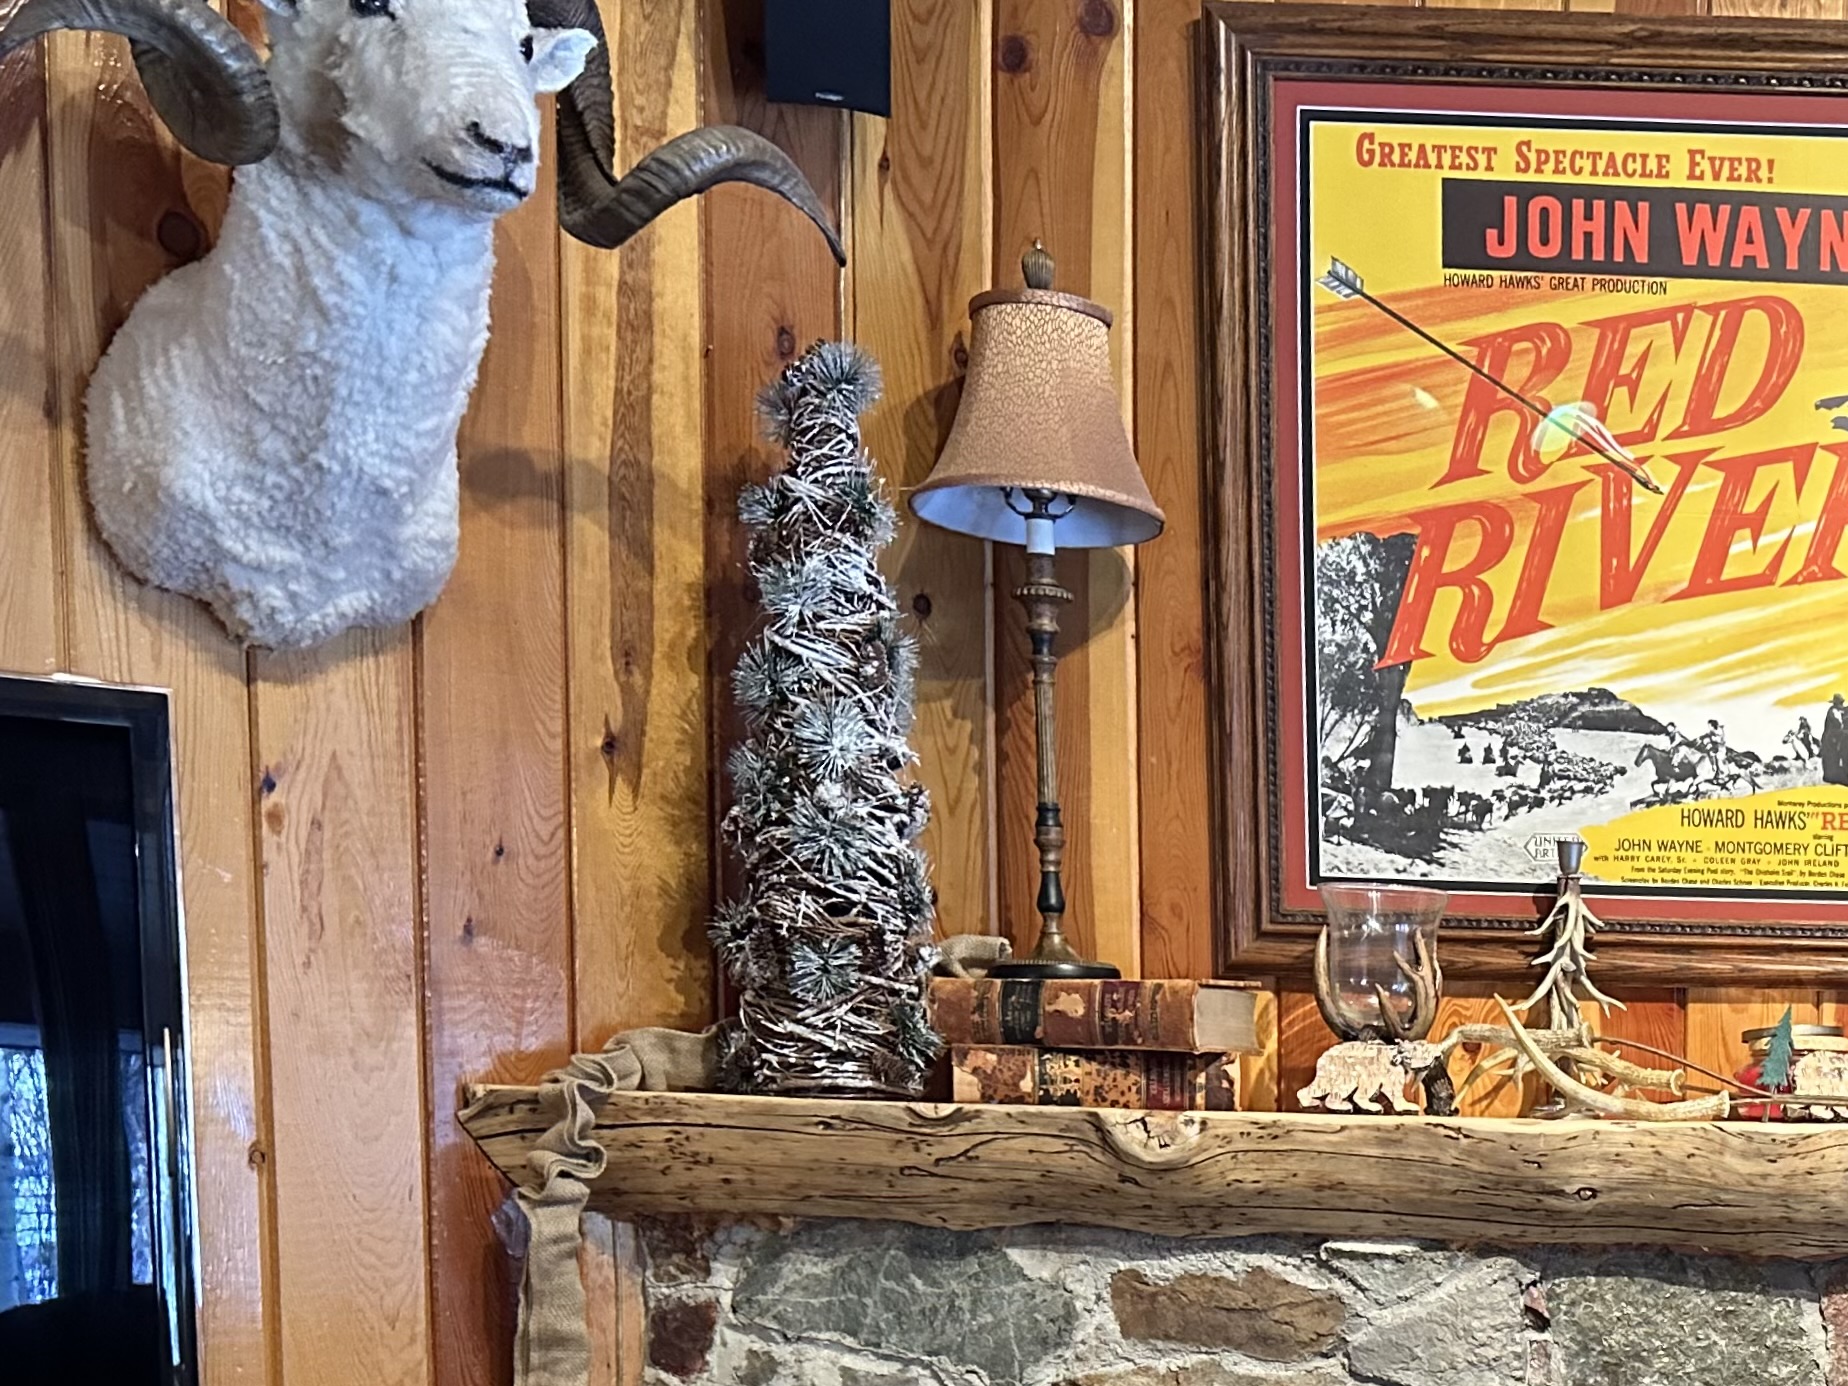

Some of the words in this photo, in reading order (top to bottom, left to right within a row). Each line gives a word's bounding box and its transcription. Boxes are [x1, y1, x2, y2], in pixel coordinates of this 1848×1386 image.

[1356, 132, 1498, 172] GREATEST
[1515, 139, 1671, 179] SPECTACLE
[1687, 148, 1775, 184] EVER!
[1486, 195, 1650, 264] JOHN
[1443, 273, 1494, 289] HOWARD
[1500, 274, 1544, 290] HAWKS'
[1550, 276, 1587, 292] GREAT
[1591, 277, 1667, 296] PRODUCTION
[1429, 295, 1805, 491] RED
[1680, 808, 1745, 828] HOWARD
[1754, 809, 1809, 830] HAWKS'
[1614, 838, 1651, 852] JOHN
[1657, 840, 1703, 854] WAYNE
[1715, 840, 1809, 856] MONTGOMERY
[1704, 857, 1736, 865] COLEEN
[1804, 859, 1839, 867] IRELAND
